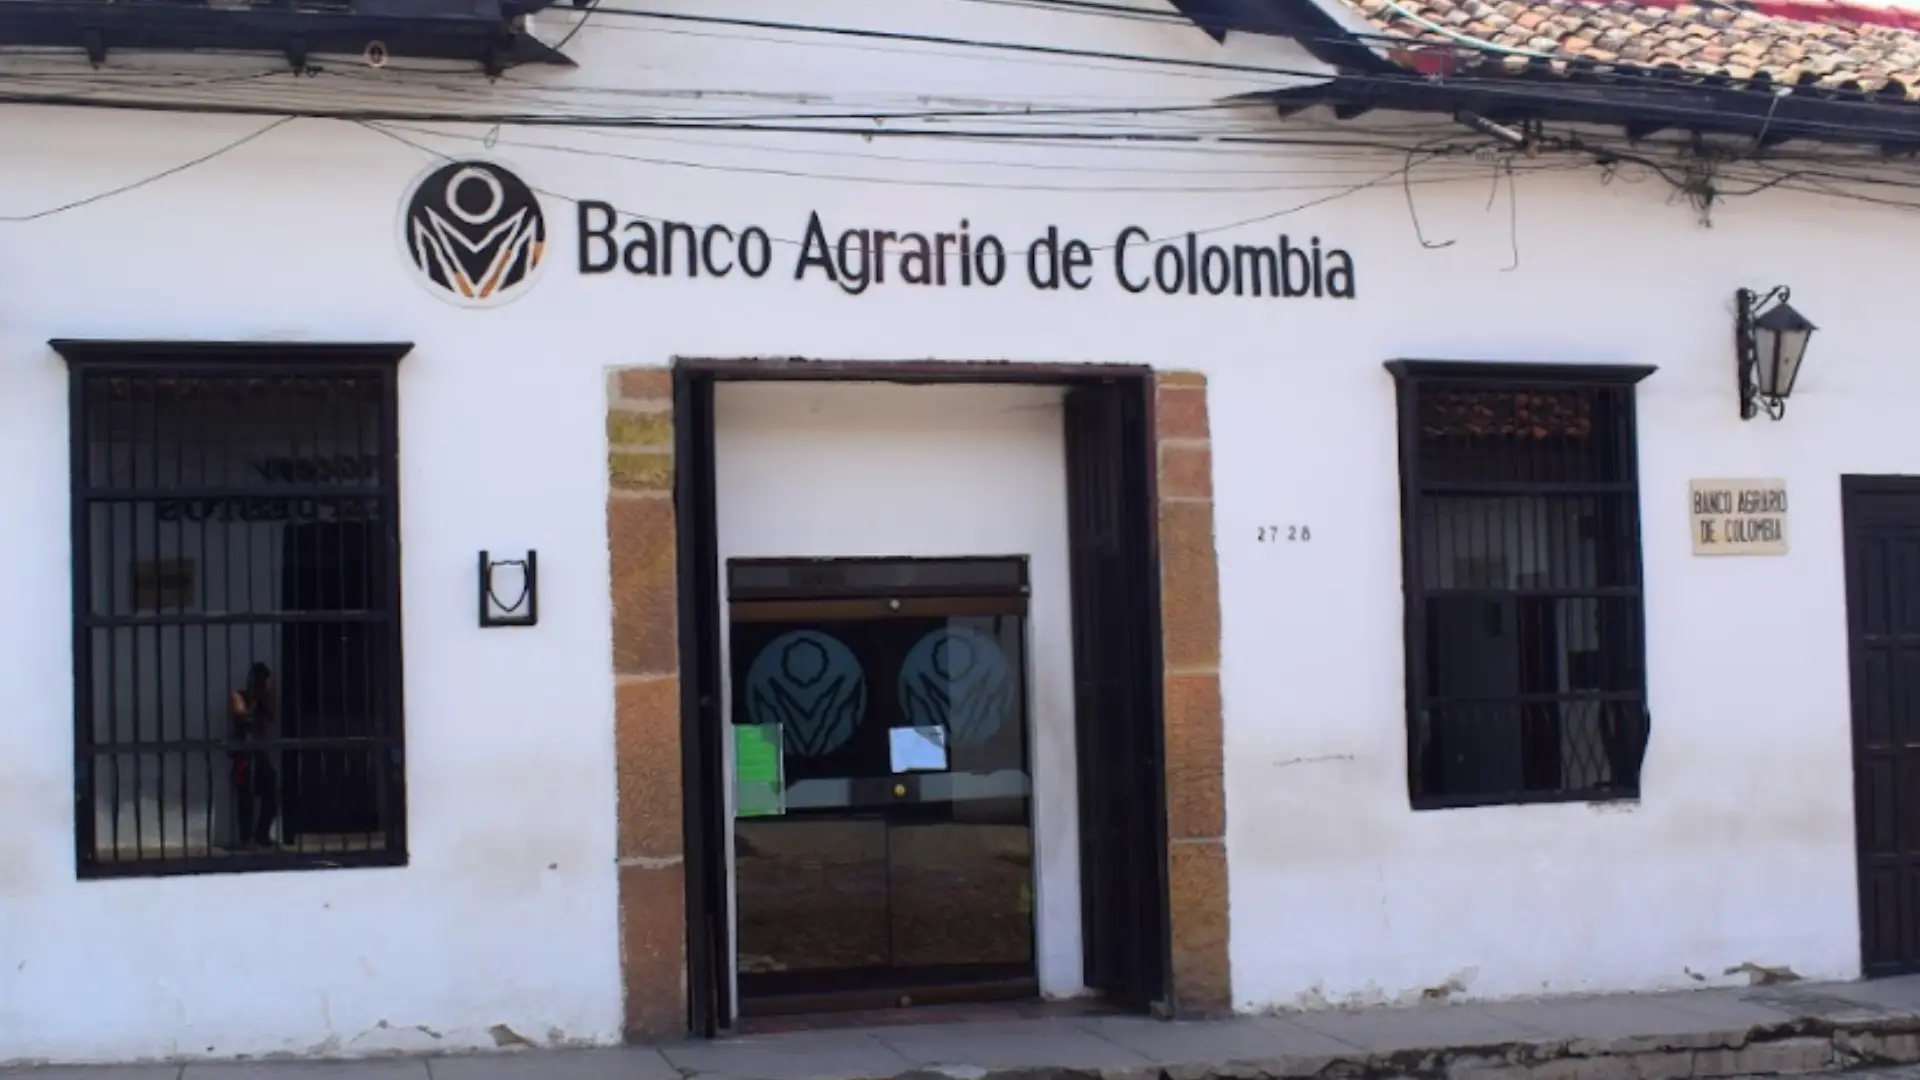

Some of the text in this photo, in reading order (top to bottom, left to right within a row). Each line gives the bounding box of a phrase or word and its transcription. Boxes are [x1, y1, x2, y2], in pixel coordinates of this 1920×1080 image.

[577, 199, 1355, 299] Banco Agrario de Colombia
[1693, 489, 1787, 513] BANCO AGRARIO
[1701, 518, 1781, 544] DE COLOMBIA
